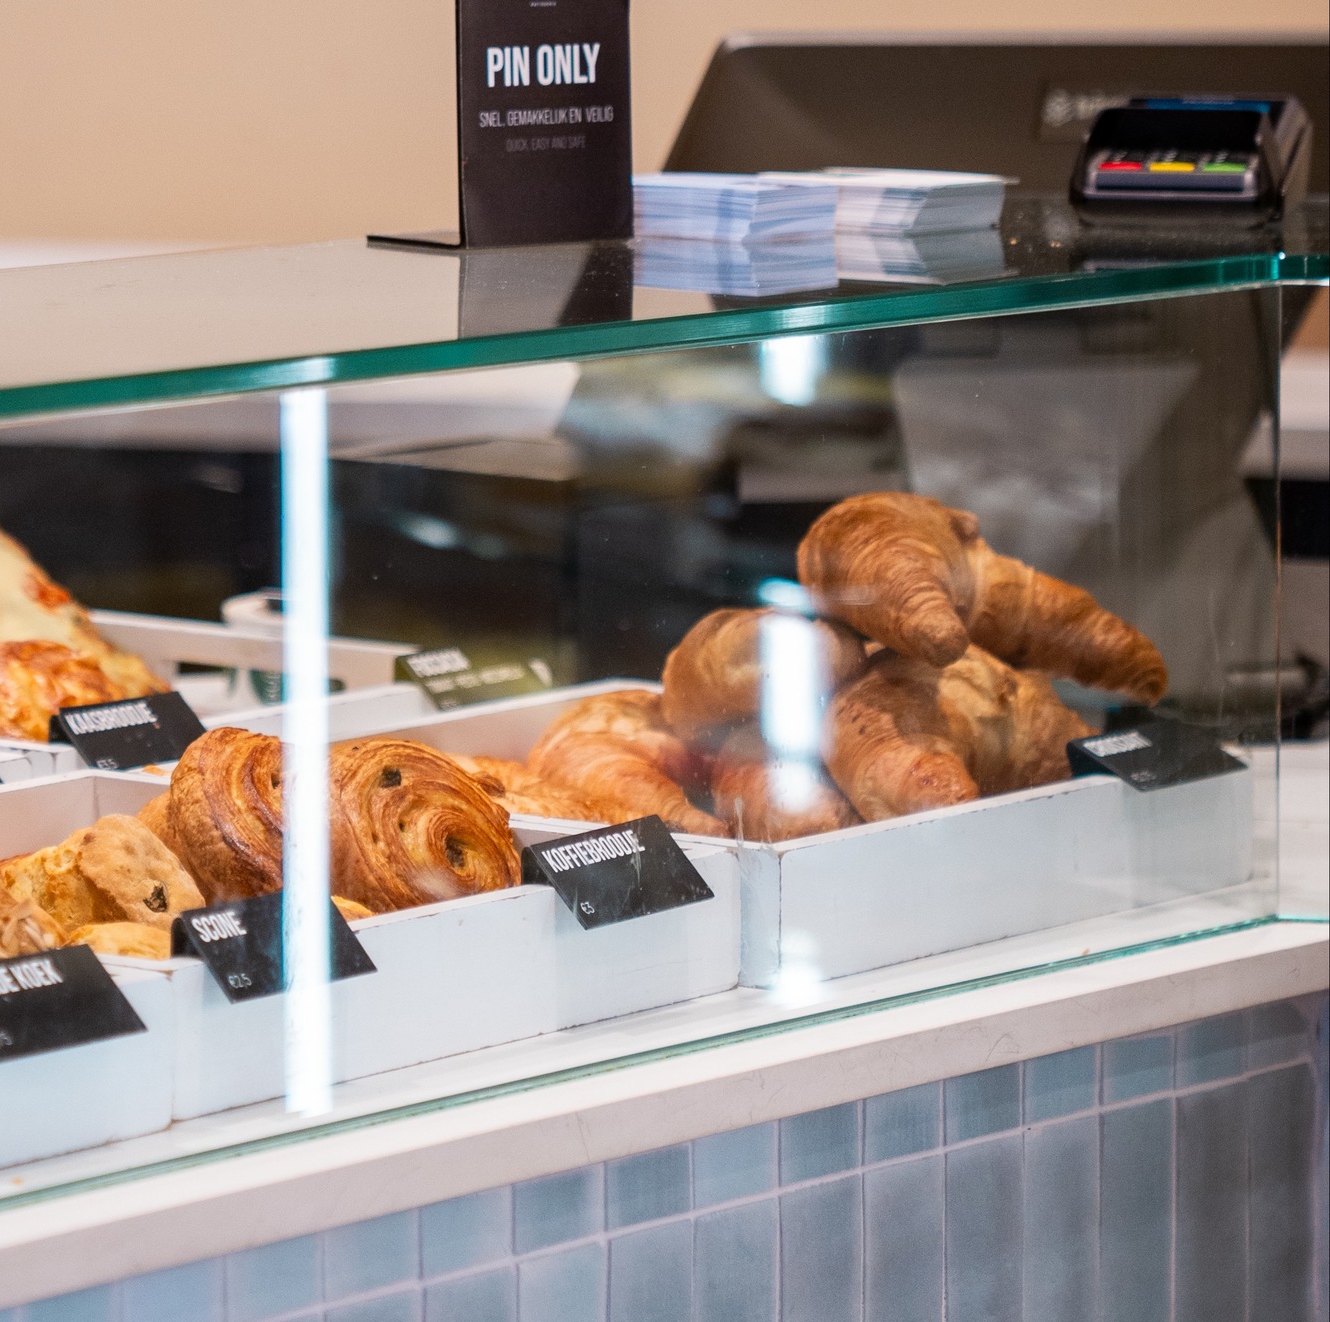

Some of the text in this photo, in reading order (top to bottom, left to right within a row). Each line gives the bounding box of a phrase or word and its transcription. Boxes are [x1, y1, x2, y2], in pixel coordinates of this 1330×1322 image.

[487, 43, 600, 88] PIN ONLY
[569, 107, 582, 123] EN
[541, 829, 646, 874] KOFFIEBROODJE
[580, 901, 595, 915] €3
[191, 911, 247, 943] SCONE
[9, 959, 64, 990] KOEK
